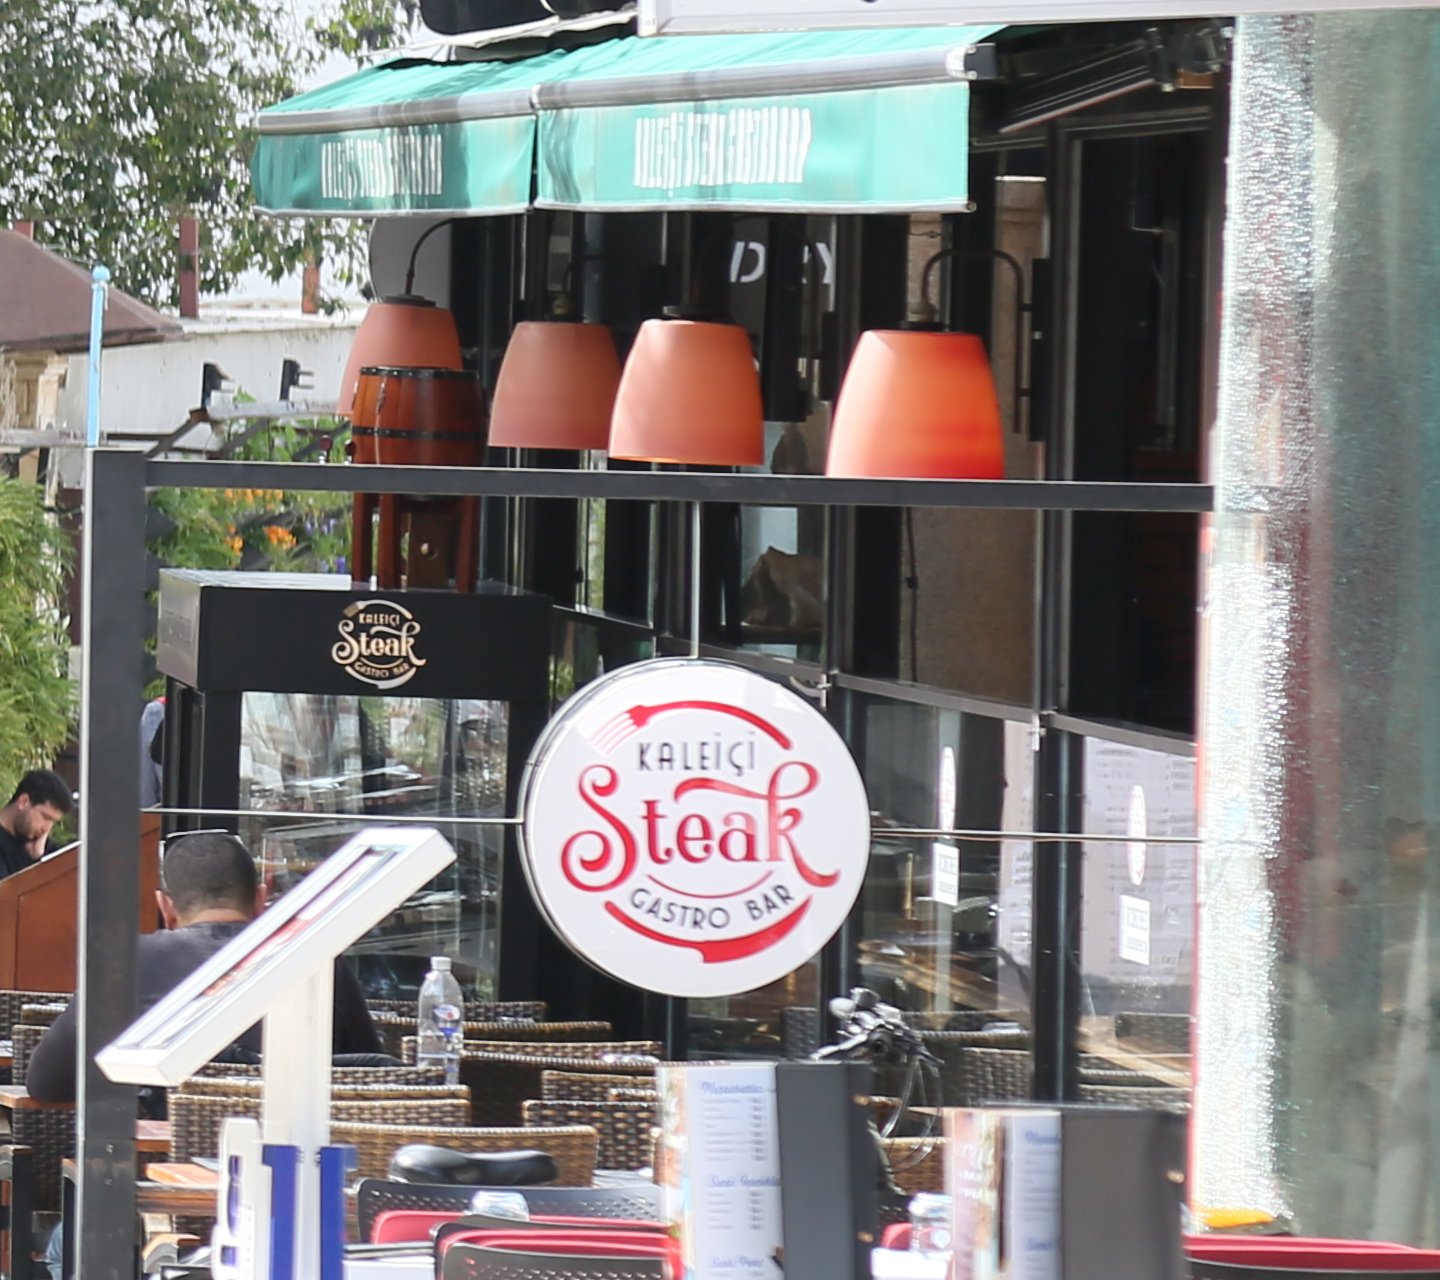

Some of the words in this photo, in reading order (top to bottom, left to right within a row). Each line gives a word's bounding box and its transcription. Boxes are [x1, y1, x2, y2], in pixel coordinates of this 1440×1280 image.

[331, 619, 427, 666] Steak
[636, 730, 757, 777] KALEİÇİ
[560, 760, 842, 893] Steak
[628, 886, 732, 931] GASTRO
[745, 885, 795, 922] BAR
